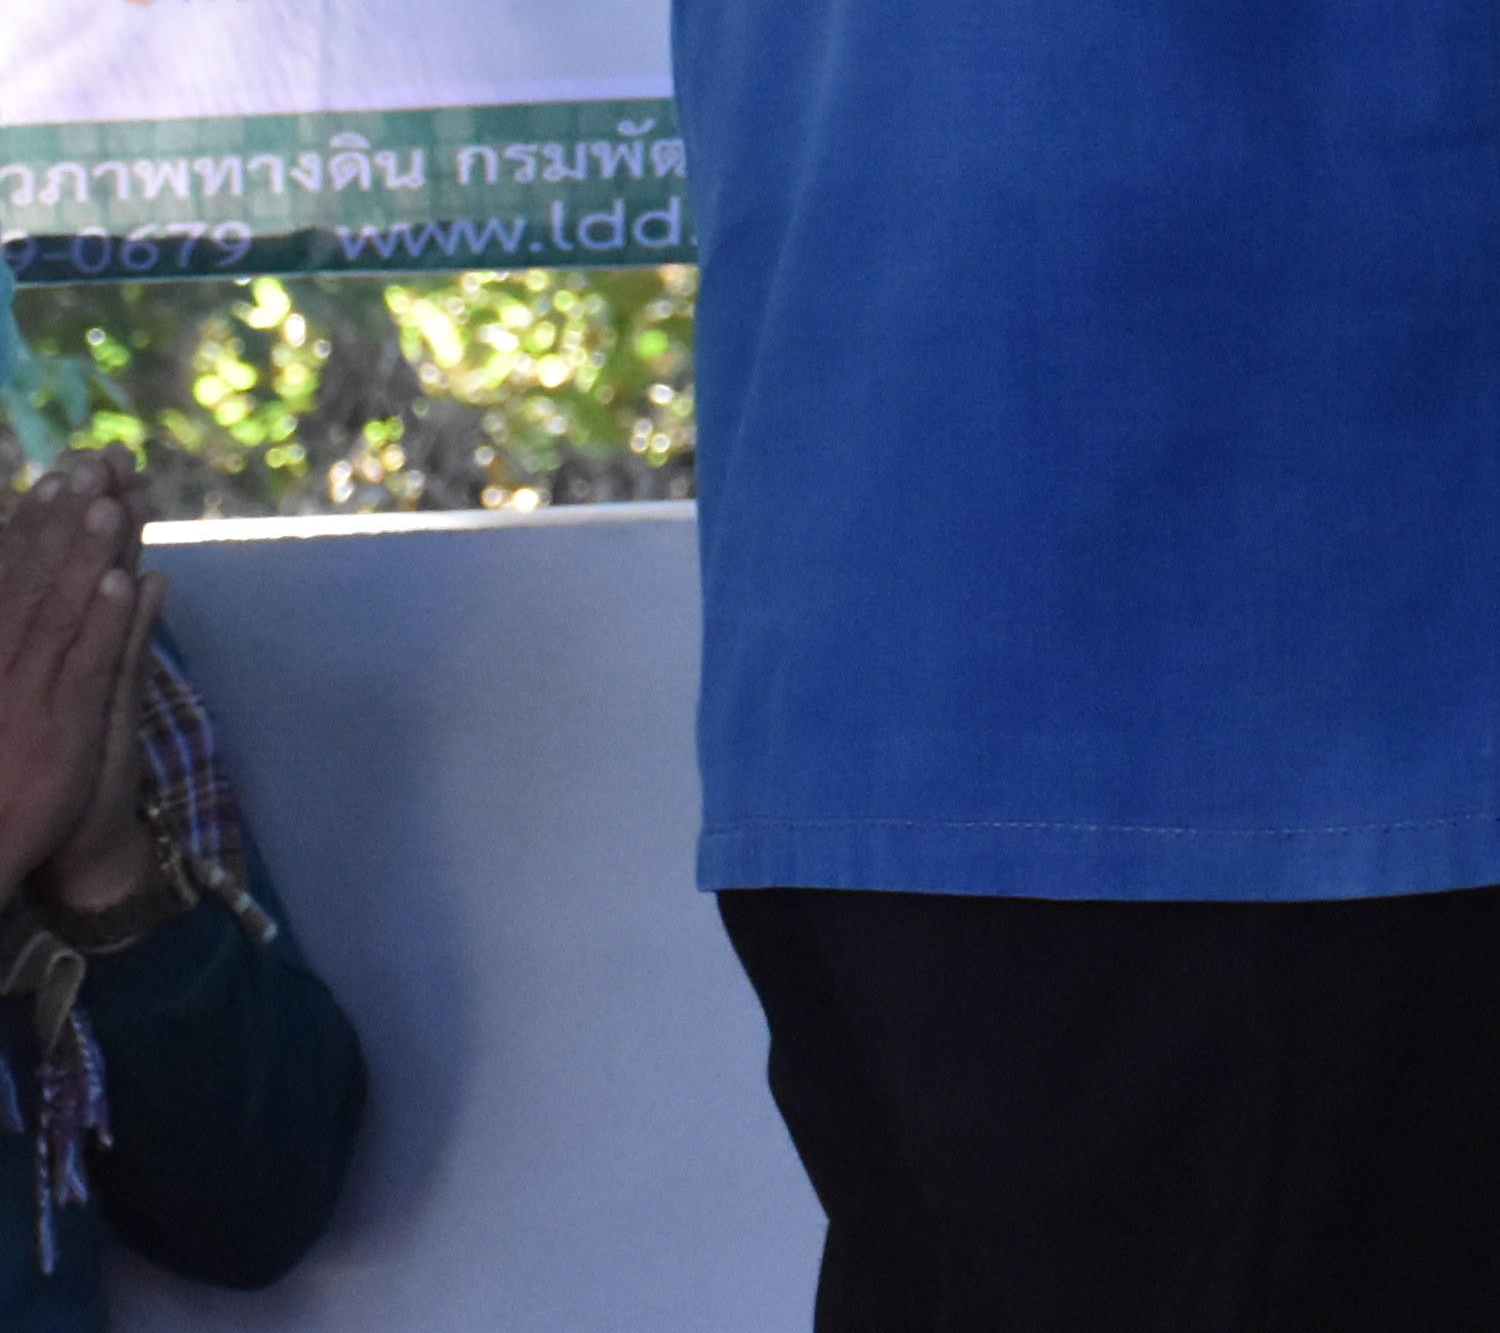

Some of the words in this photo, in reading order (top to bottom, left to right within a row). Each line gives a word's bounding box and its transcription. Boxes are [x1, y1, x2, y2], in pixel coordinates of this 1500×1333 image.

[0, 132, 424, 206] วภาพทางดิน
[335, 197, 700, 263] www.ldd.
